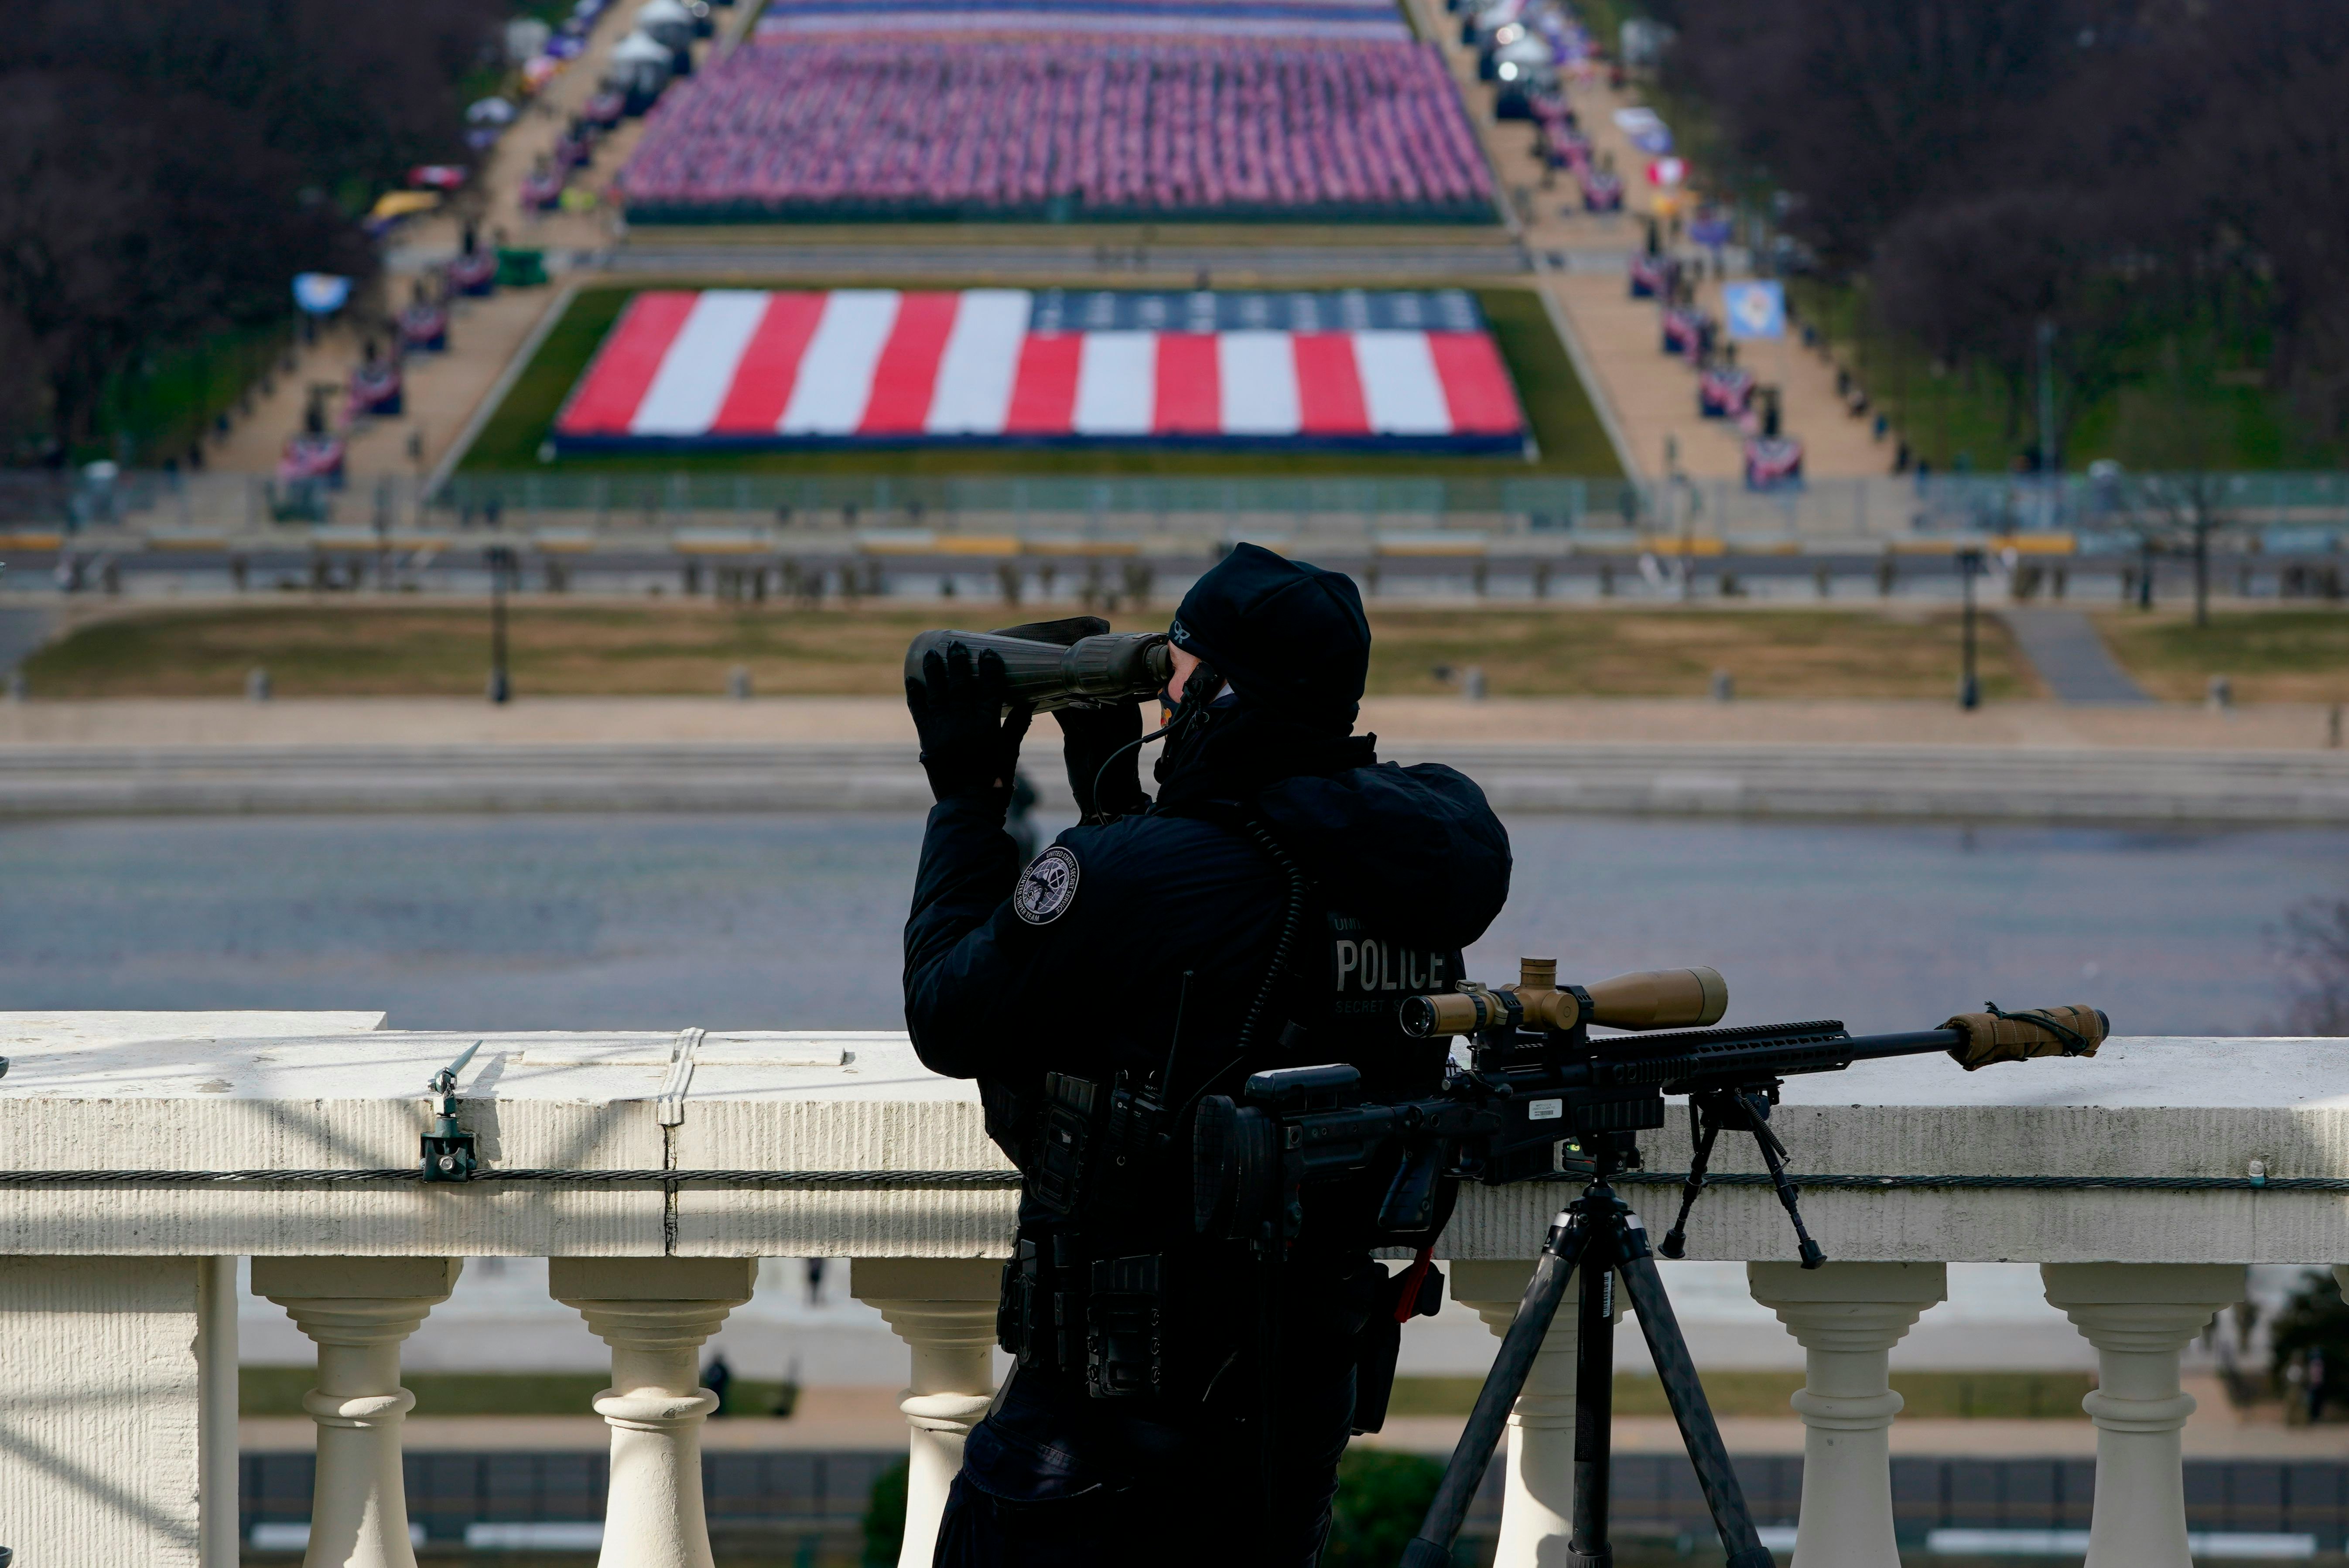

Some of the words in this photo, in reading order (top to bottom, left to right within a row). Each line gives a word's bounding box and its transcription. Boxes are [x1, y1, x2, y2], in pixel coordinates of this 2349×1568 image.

[1046, 850, 1063, 858] UNITED
[1062, 853, 1074, 868] STATES
[1017, 866, 1033, 895] COUNTER
[1068, 867, 1077, 890] SECRET
[1016, 895, 1026, 915] SNIPER
[1055, 889, 1072, 914] SERVICE
[1025, 912, 1040, 922] TEAM
[1337, 939, 1443, 991] POLICE
[1335, 999, 1385, 1014] SECRET
